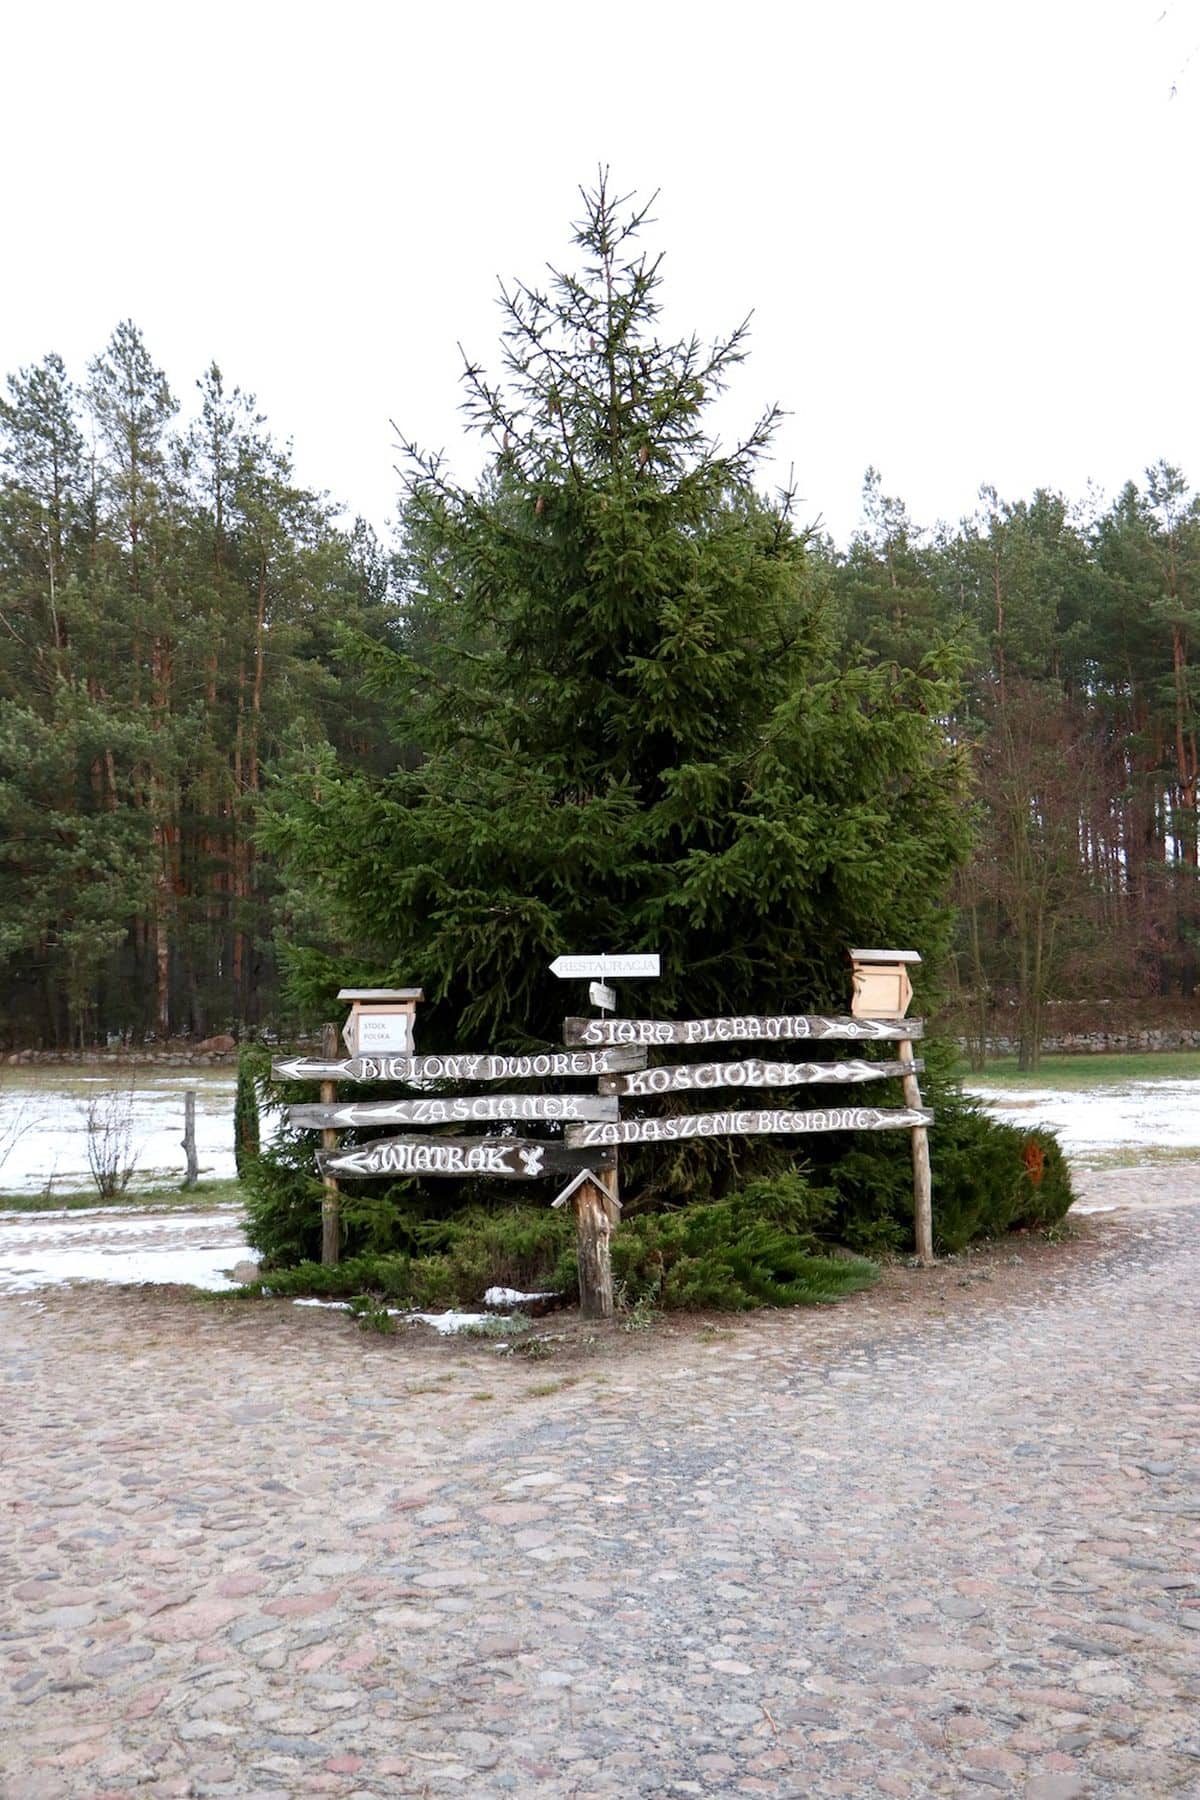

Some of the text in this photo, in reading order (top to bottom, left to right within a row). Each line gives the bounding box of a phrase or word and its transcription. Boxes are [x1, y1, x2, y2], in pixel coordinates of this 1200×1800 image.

[559, 958, 657, 973] RESTAURACJA
[363, 1032, 391, 1040] POLSKA
[581, 1016, 811, 1044] STARA PLEBANIA
[489, 1051, 610, 1079] DWOREK
[412, 1097, 585, 1121] ZAŚCIANEK
[583, 1108, 870, 1145] ZADASZENIE BIESIADNE
[378, 1143, 515, 1173] WIATRAK
